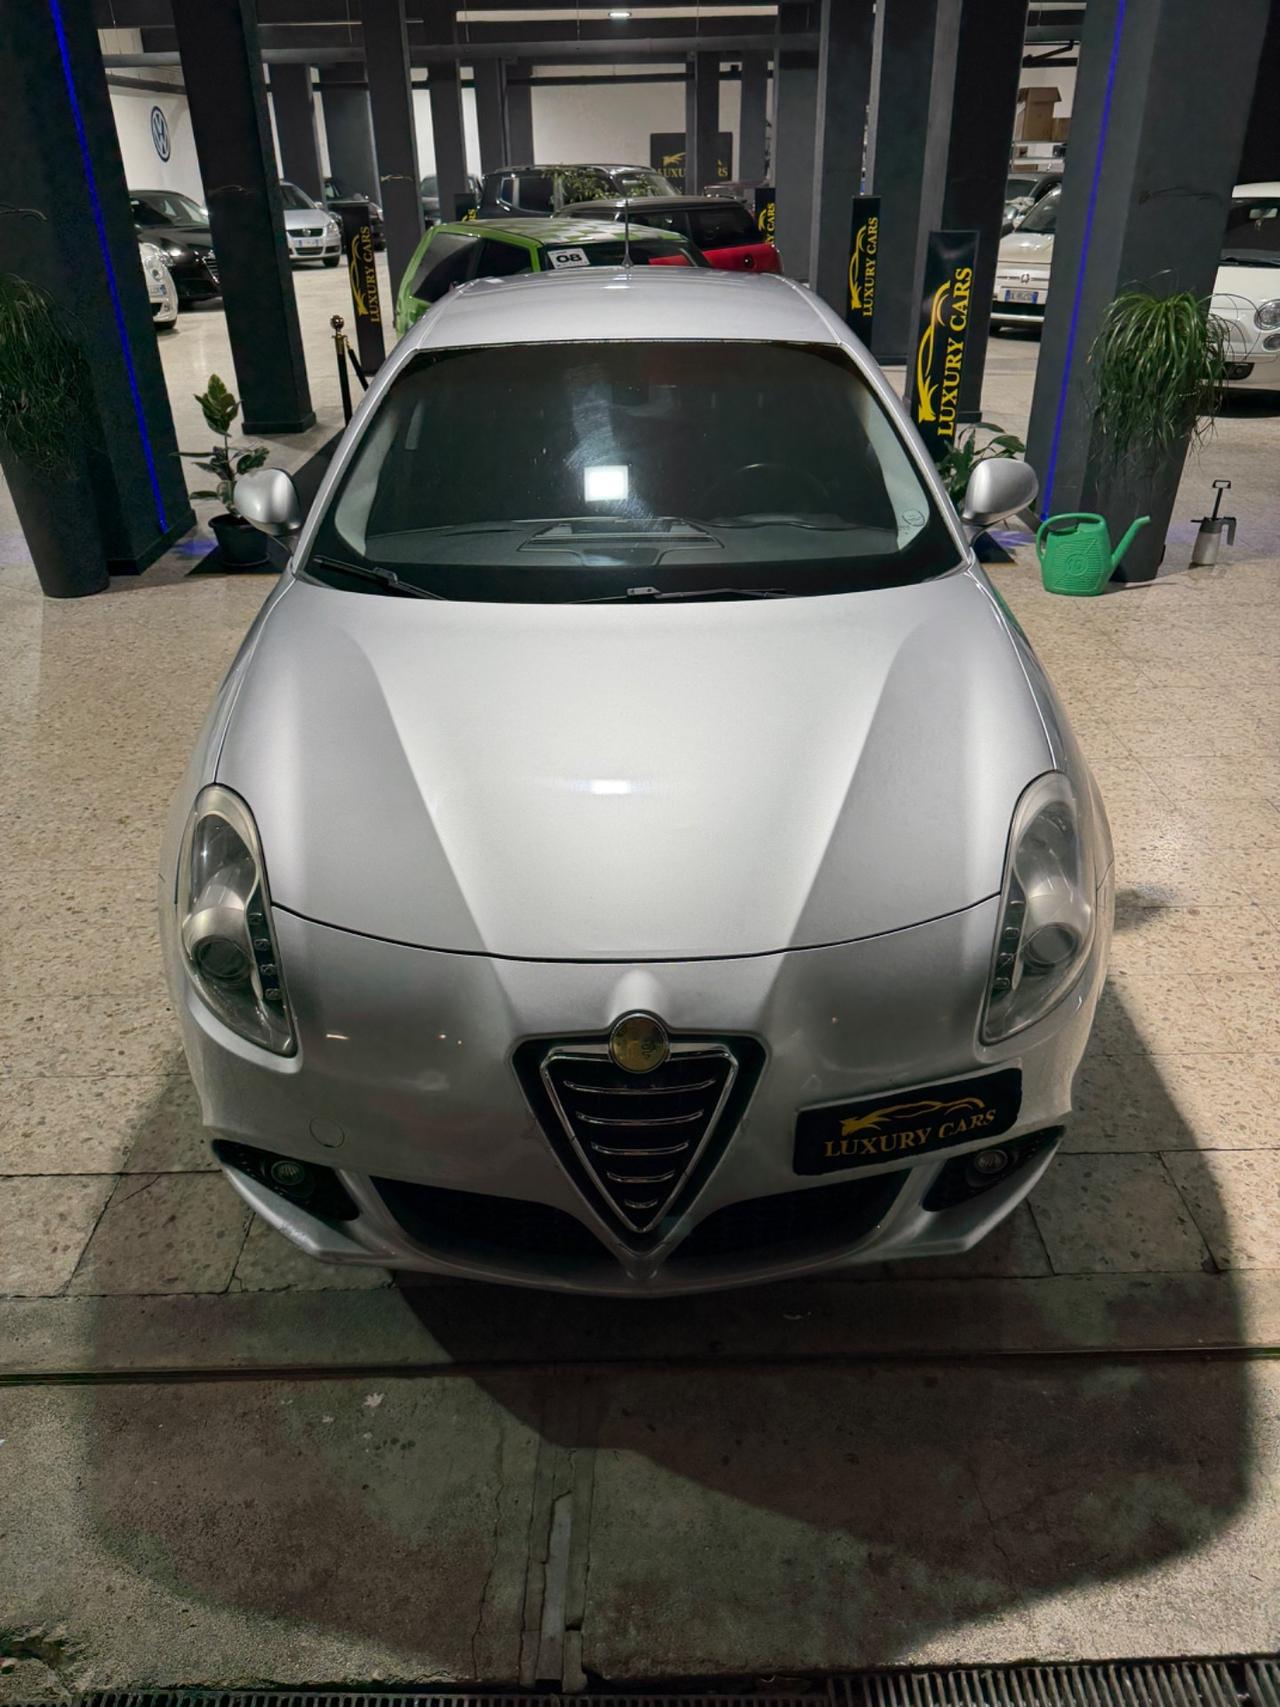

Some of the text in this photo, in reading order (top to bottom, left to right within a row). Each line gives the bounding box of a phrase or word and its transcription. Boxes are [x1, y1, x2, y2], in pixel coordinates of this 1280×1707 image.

[767, 203, 775, 231] CARS
[360, 226, 380, 322] LUXURY CARS
[556, 253, 582, 263] 08
[863, 217, 879, 317] LUXURY CARS
[937, 267, 973, 436] LUXURY CARS
[824, 1109, 997, 1157] LUXURY CARS
